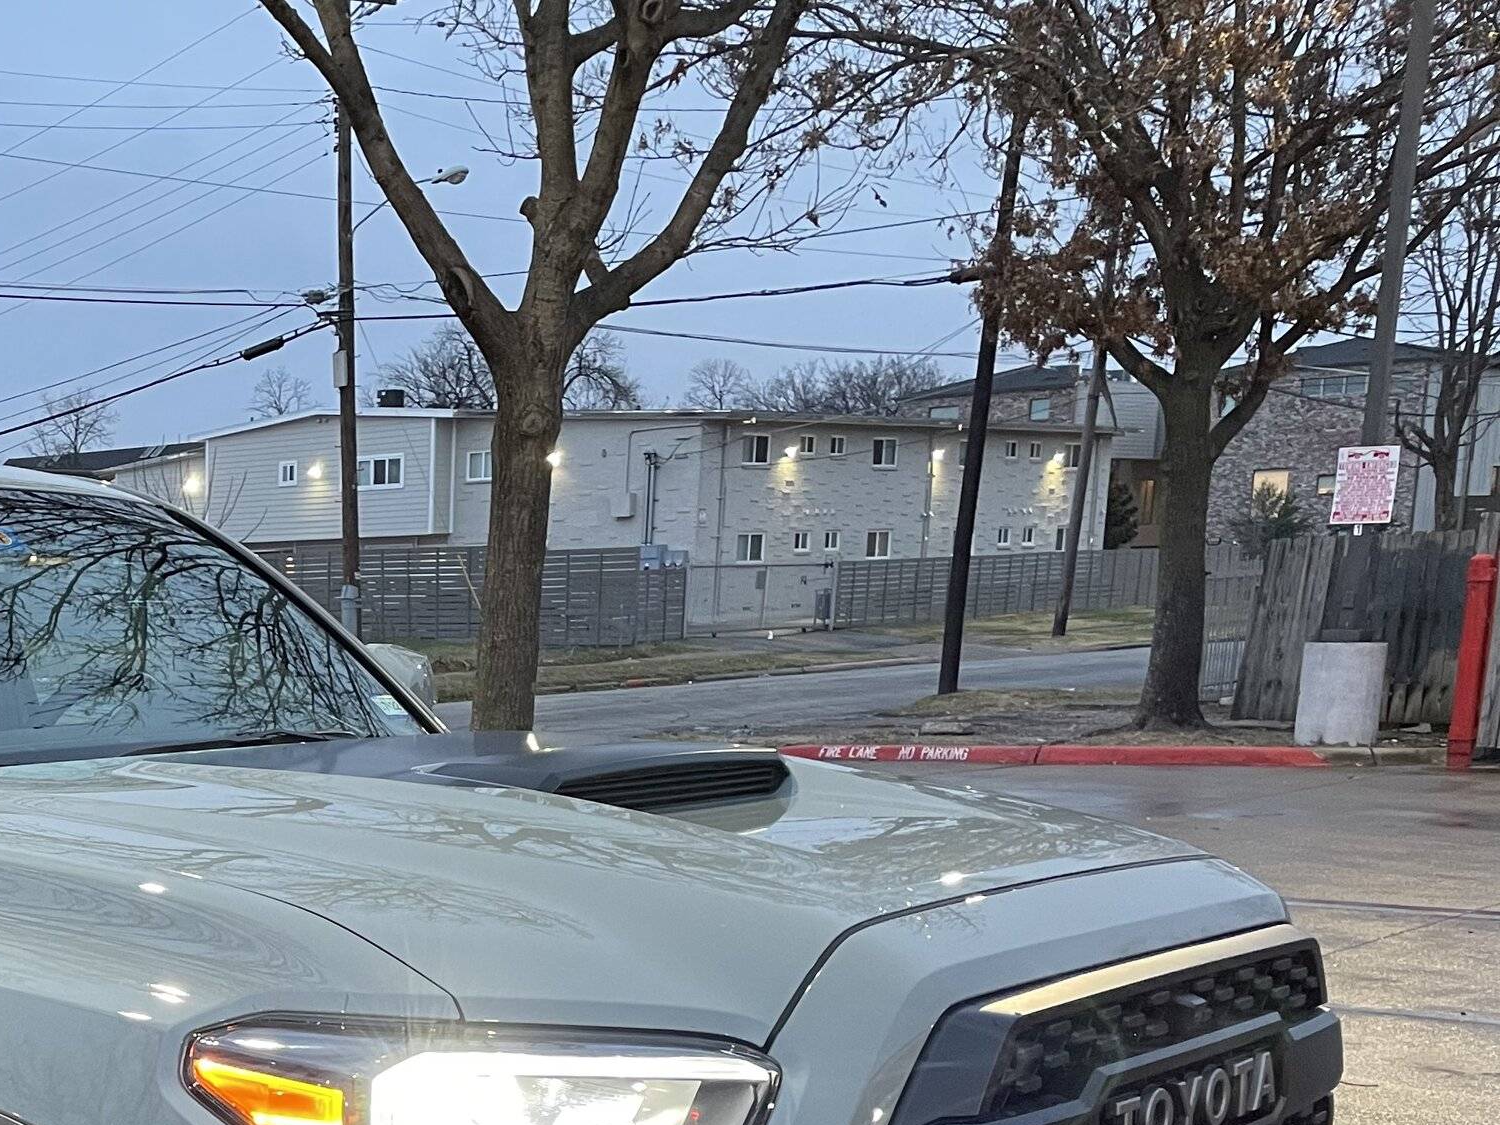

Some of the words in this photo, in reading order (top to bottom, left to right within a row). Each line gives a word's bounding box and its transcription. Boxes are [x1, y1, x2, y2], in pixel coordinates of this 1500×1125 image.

[818, 745, 846, 758] FIRE
[848, 745, 880, 759] LANE
[897, 746, 915, 760] NO
[920, 746, 969, 760] PARKING
